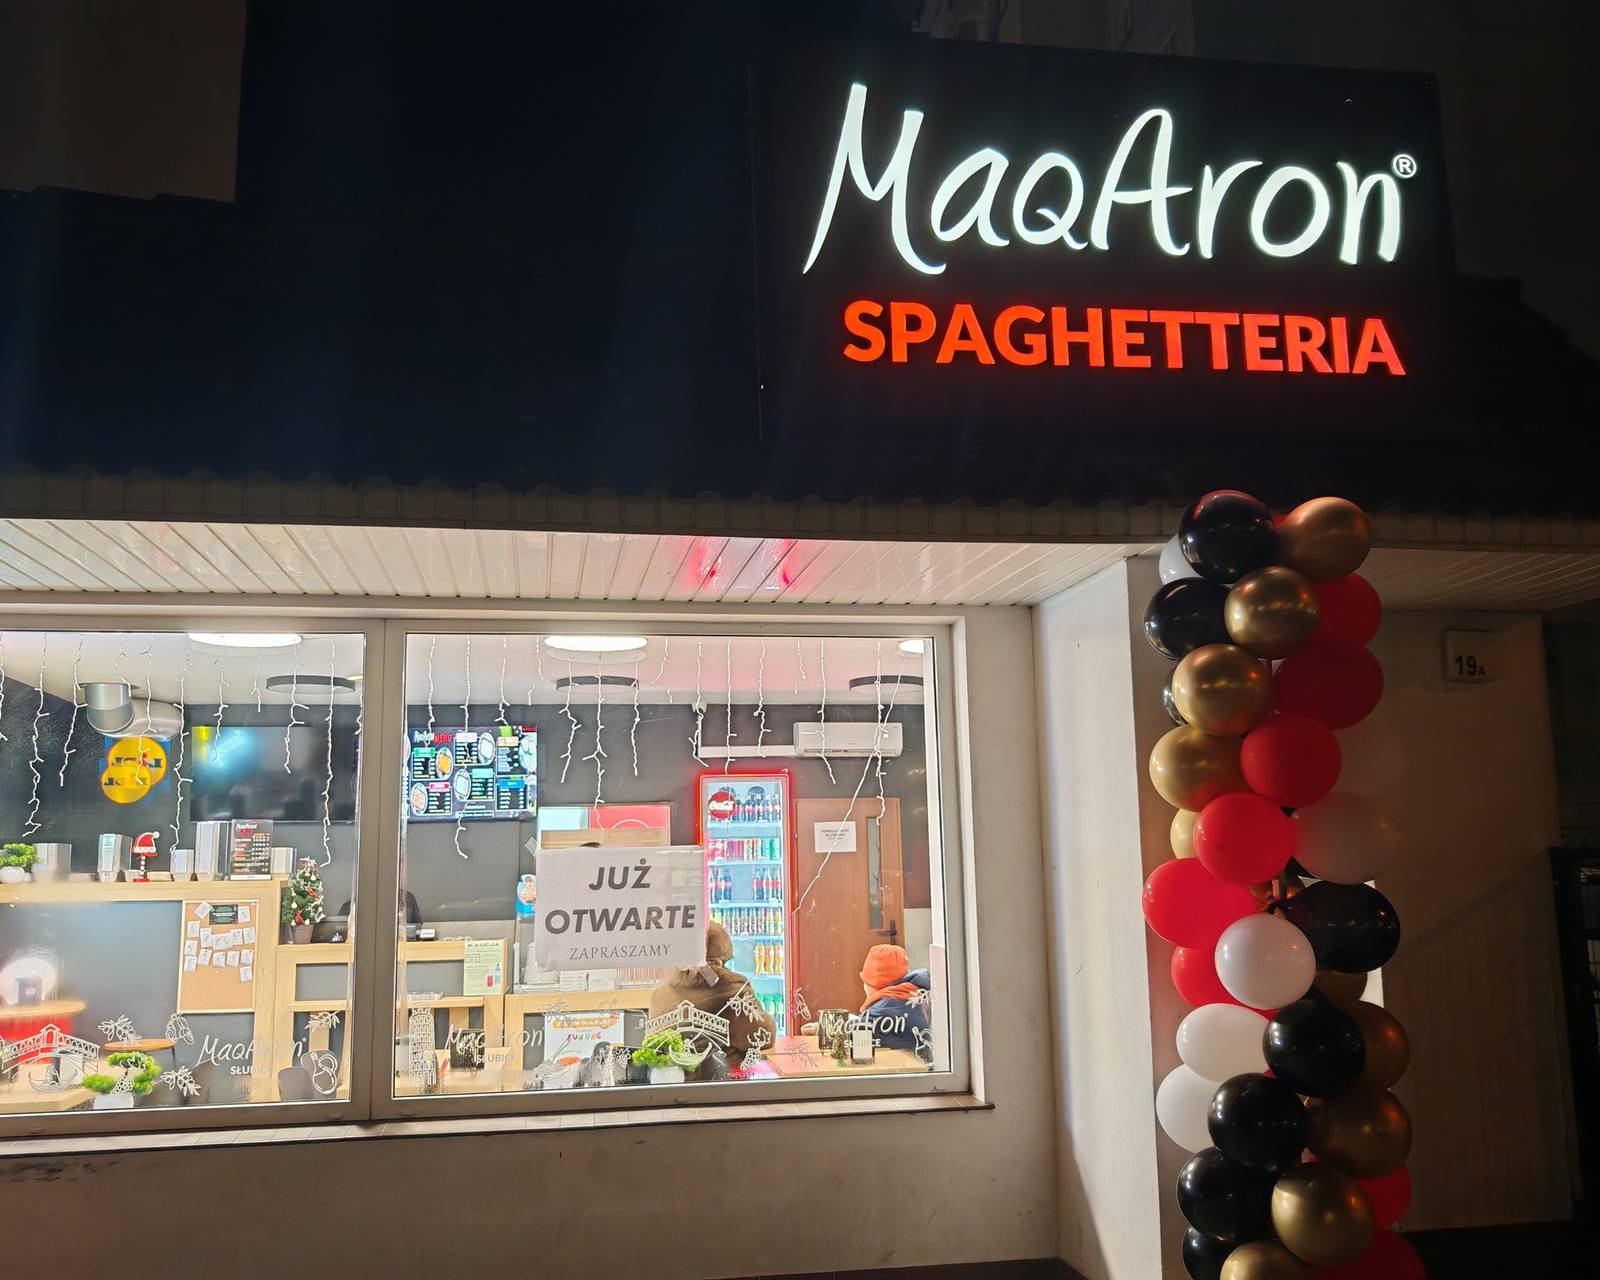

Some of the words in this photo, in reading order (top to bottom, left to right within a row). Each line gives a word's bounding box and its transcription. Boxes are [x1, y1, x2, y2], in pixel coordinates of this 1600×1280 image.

[842, 299, 1406, 376] SPAGHETTERIA
[588, 858, 652, 891] JUŻ
[545, 904, 697, 935] OTWARTE
[569, 943, 671, 961] ZAPRASZAMY
